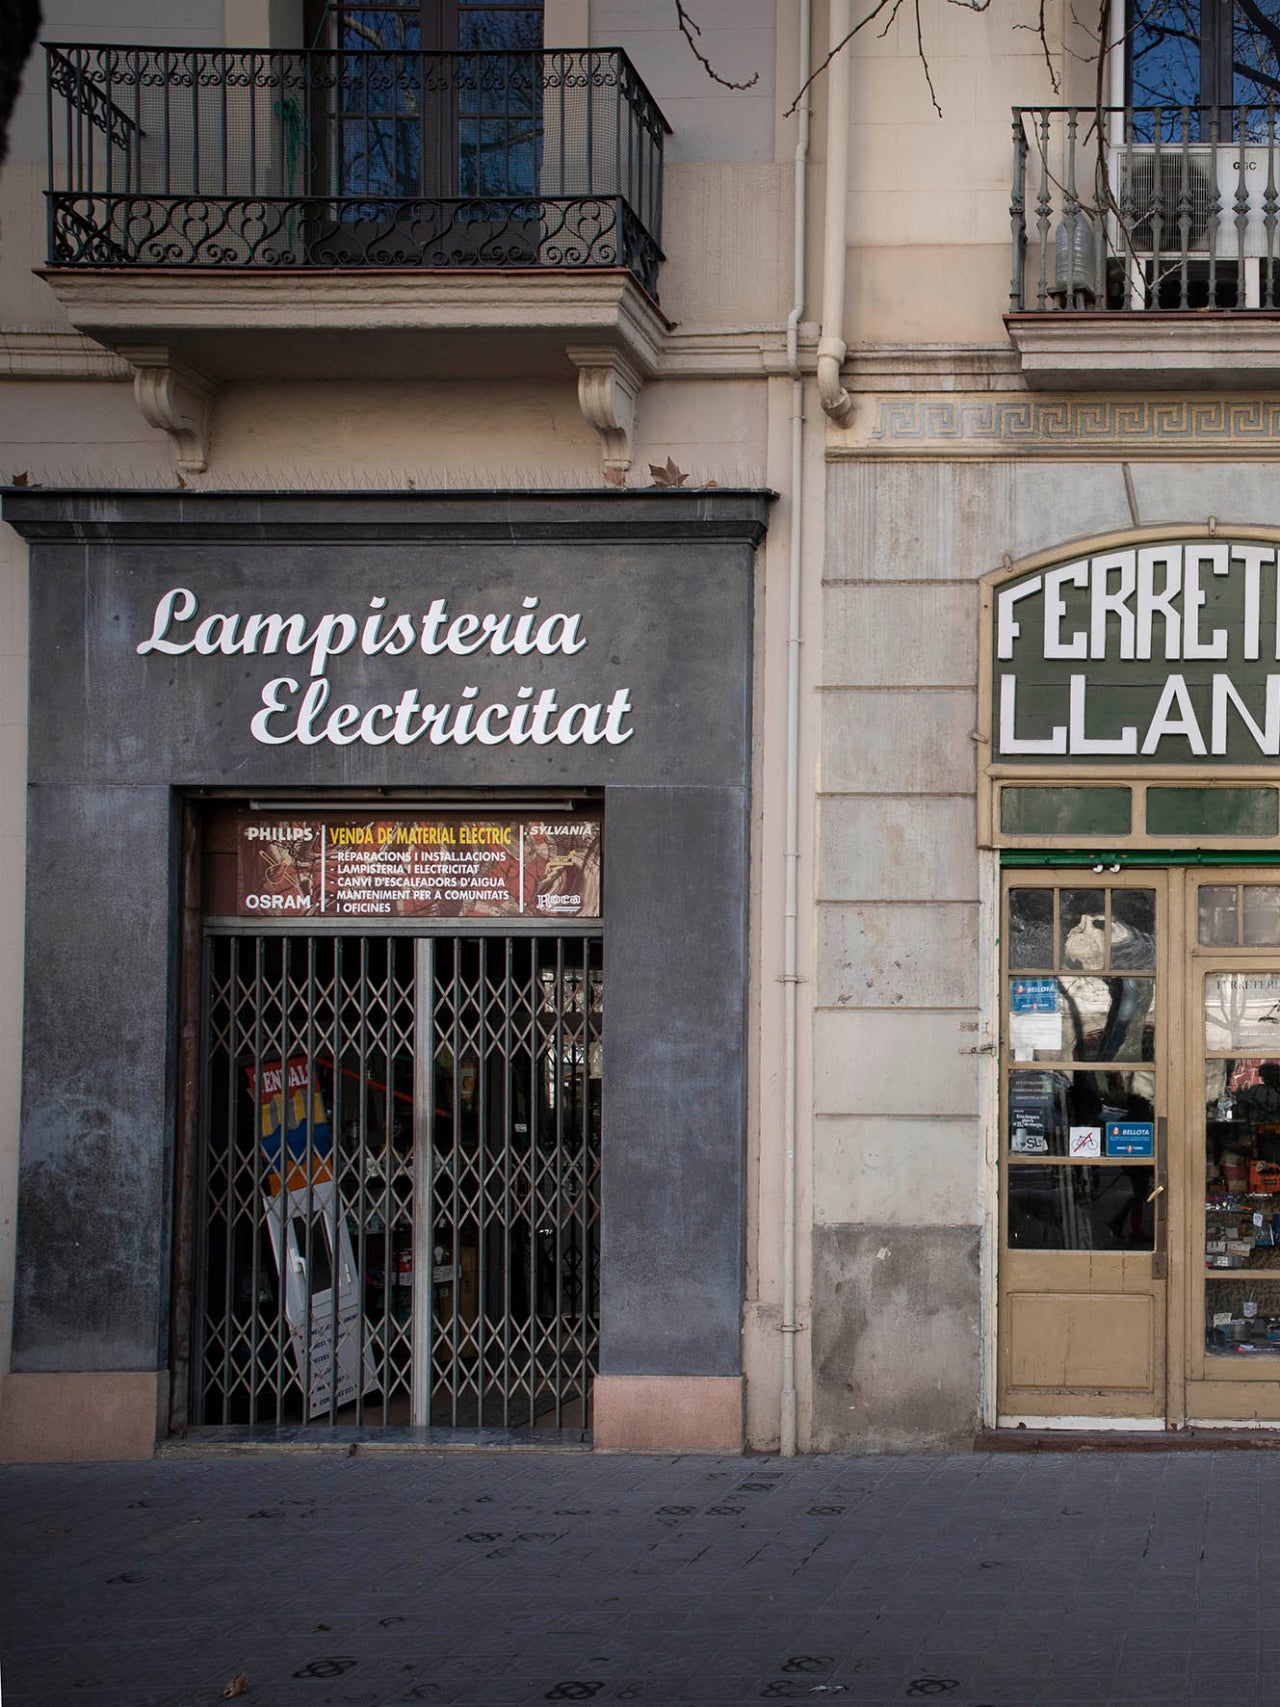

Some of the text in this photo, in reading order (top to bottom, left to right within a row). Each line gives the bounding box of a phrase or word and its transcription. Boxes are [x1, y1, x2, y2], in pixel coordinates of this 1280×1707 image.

[136, 587, 588, 677] Lampisteria
[250, 676, 636, 746] Electricitat
[247, 826, 314, 841] PHILIPS
[329, 823, 512, 845] VENDA DE MATERIAL ELÈCTRIC
[529, 825, 592, 836] SYLVANIA
[337, 851, 412, 862] REPARACIONS
[414, 851, 419, 862] I
[337, 864, 480, 875] LAMPISTERIA I ELECTRICITAT
[337, 877, 506, 888] CANVI D'ESCALFADORS D'AIGUA
[336, 889, 510, 901] MANTENIMENT PER A COMUNITATS
[536, 894, 581, 908] Roca
[245, 894, 311, 909] OSRAM
[336, 902, 392, 913] I OFICINES
[1026, 985, 1056, 994] BELLOTA
